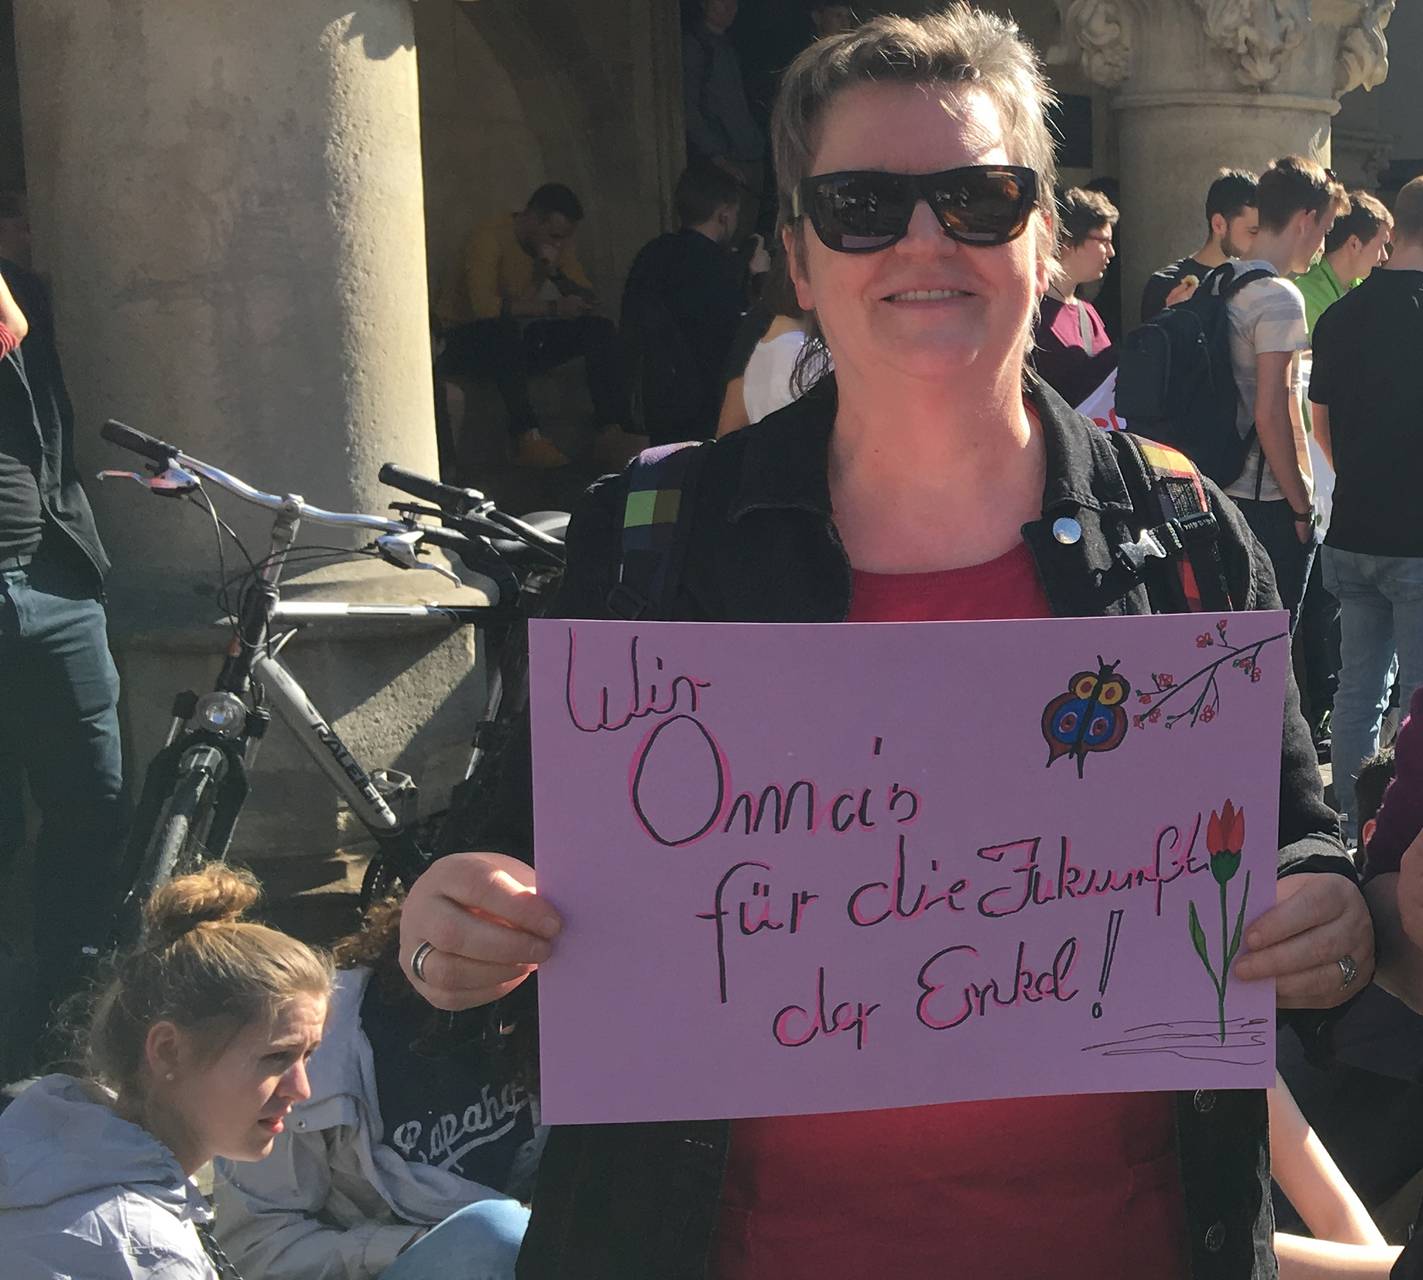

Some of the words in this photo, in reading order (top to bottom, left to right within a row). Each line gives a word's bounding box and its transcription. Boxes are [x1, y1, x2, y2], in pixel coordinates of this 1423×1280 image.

[565, 626, 711, 732] Wir
[311, 722, 389, 816] RALEIGH
[695, 861, 819, 1003] für
[847, 834, 970, 927] die
[773, 966, 881, 1050] der
